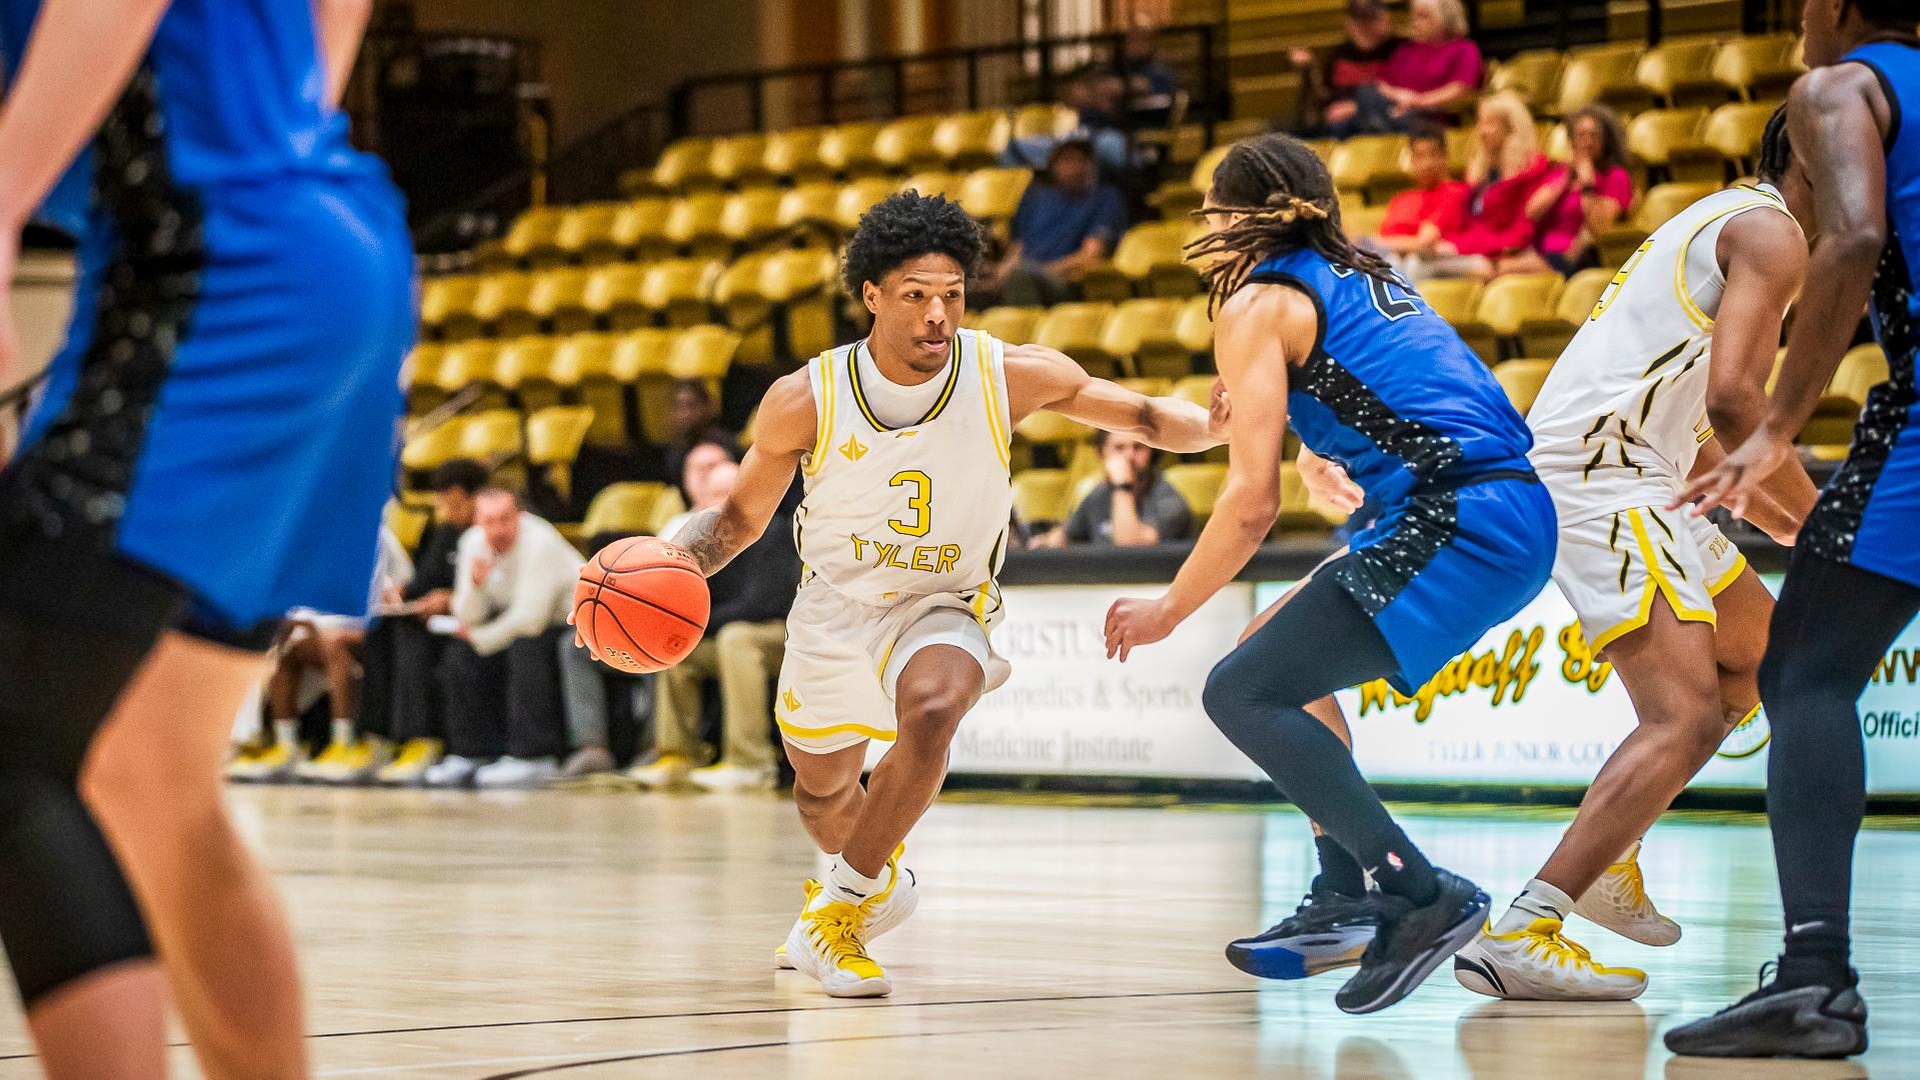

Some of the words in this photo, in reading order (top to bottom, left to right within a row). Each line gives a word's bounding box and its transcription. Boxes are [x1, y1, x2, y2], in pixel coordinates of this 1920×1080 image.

[888, 470, 932, 538] 3
[850, 533, 962, 574] TYLER
[957, 729, 1055, 762] Medicine
